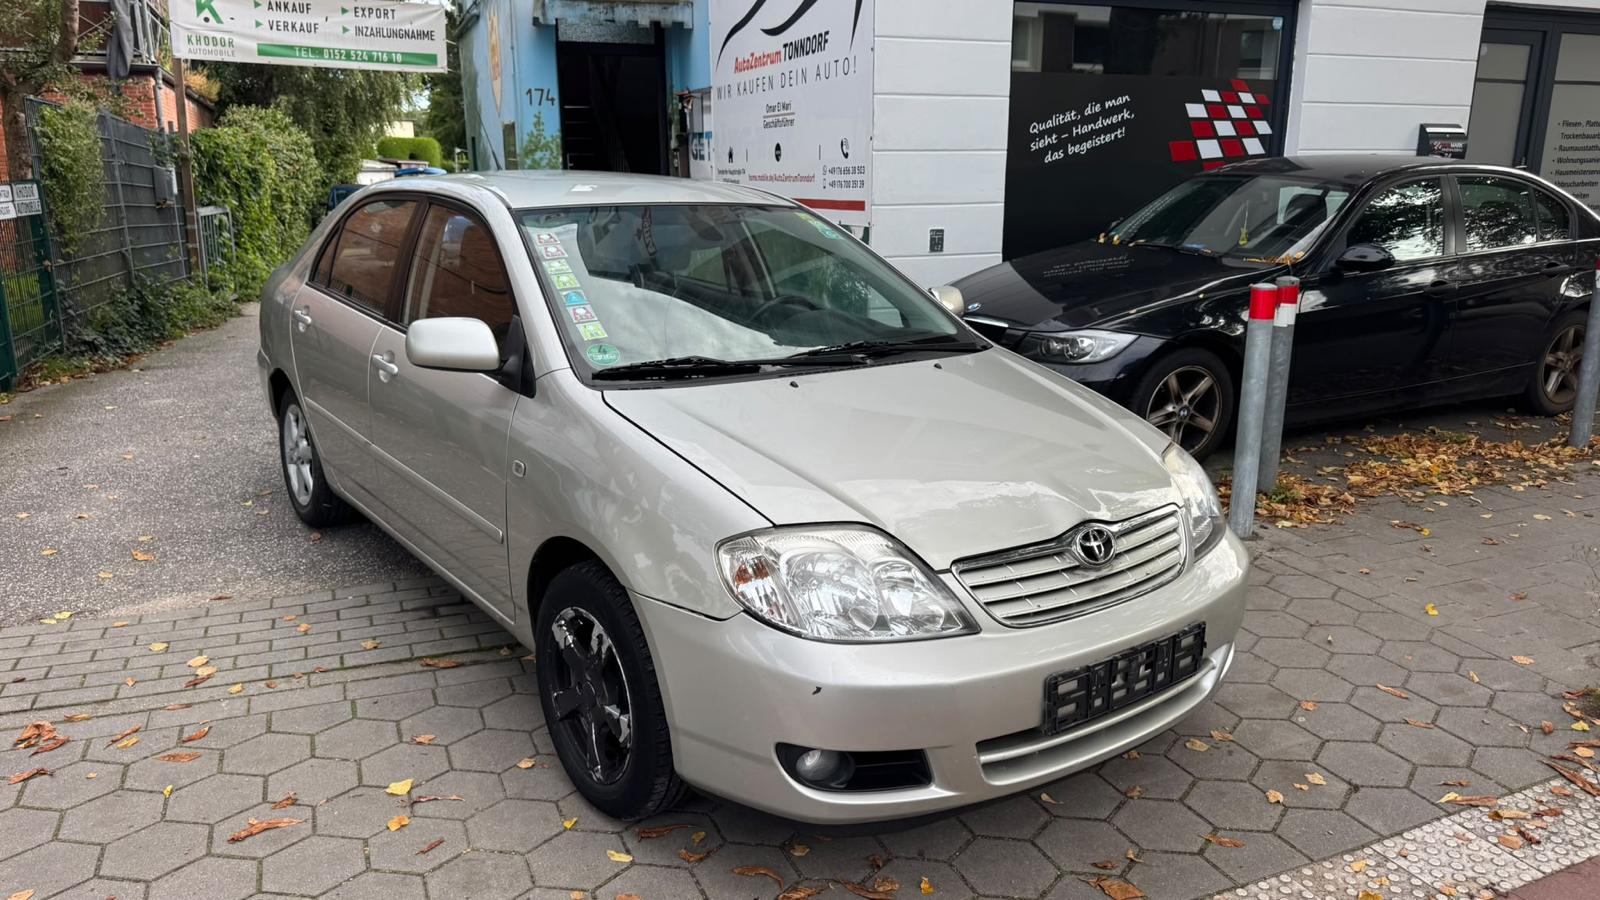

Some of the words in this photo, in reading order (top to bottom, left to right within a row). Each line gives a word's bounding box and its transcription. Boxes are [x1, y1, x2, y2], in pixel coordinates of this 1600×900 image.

[267, 0, 312, 14] ANKAUF
[354, 6, 396, 20] EXPORT
[268, 19, 319, 34] VERKAUF
[355, 25, 436, 41] INZAHLUNGNAHME
[187, 34, 235, 48] KHODOR
[188, 47, 236, 58] AUTOMOBILE
[323, 48, 346, 60] 0152
[350, 50, 369, 61] 524
[372, 51, 388, 62] 716
[391, 53, 402, 63] 10
[734, 48, 782, 73] AutoZentrum
[783, 30, 830, 61] TONNDORF
[717, 84, 732, 101] WIR
[737, 75, 774, 97] KAUFEN
[780, 67, 808, 88] DEIN
[815, 55, 857, 81] AUTO!
[526, 88, 556, 106] 174
[1029, 109, 1081, 134] Qualität,
[1084, 102, 1102, 116] die
[1105, 94, 1131, 109] man
[1030, 133, 1058, 152] sieht
[1072, 107, 1135, 137] Handwerk,
[1044, 149, 1065, 163] das
[1067, 126, 1126, 155] begeistert!
